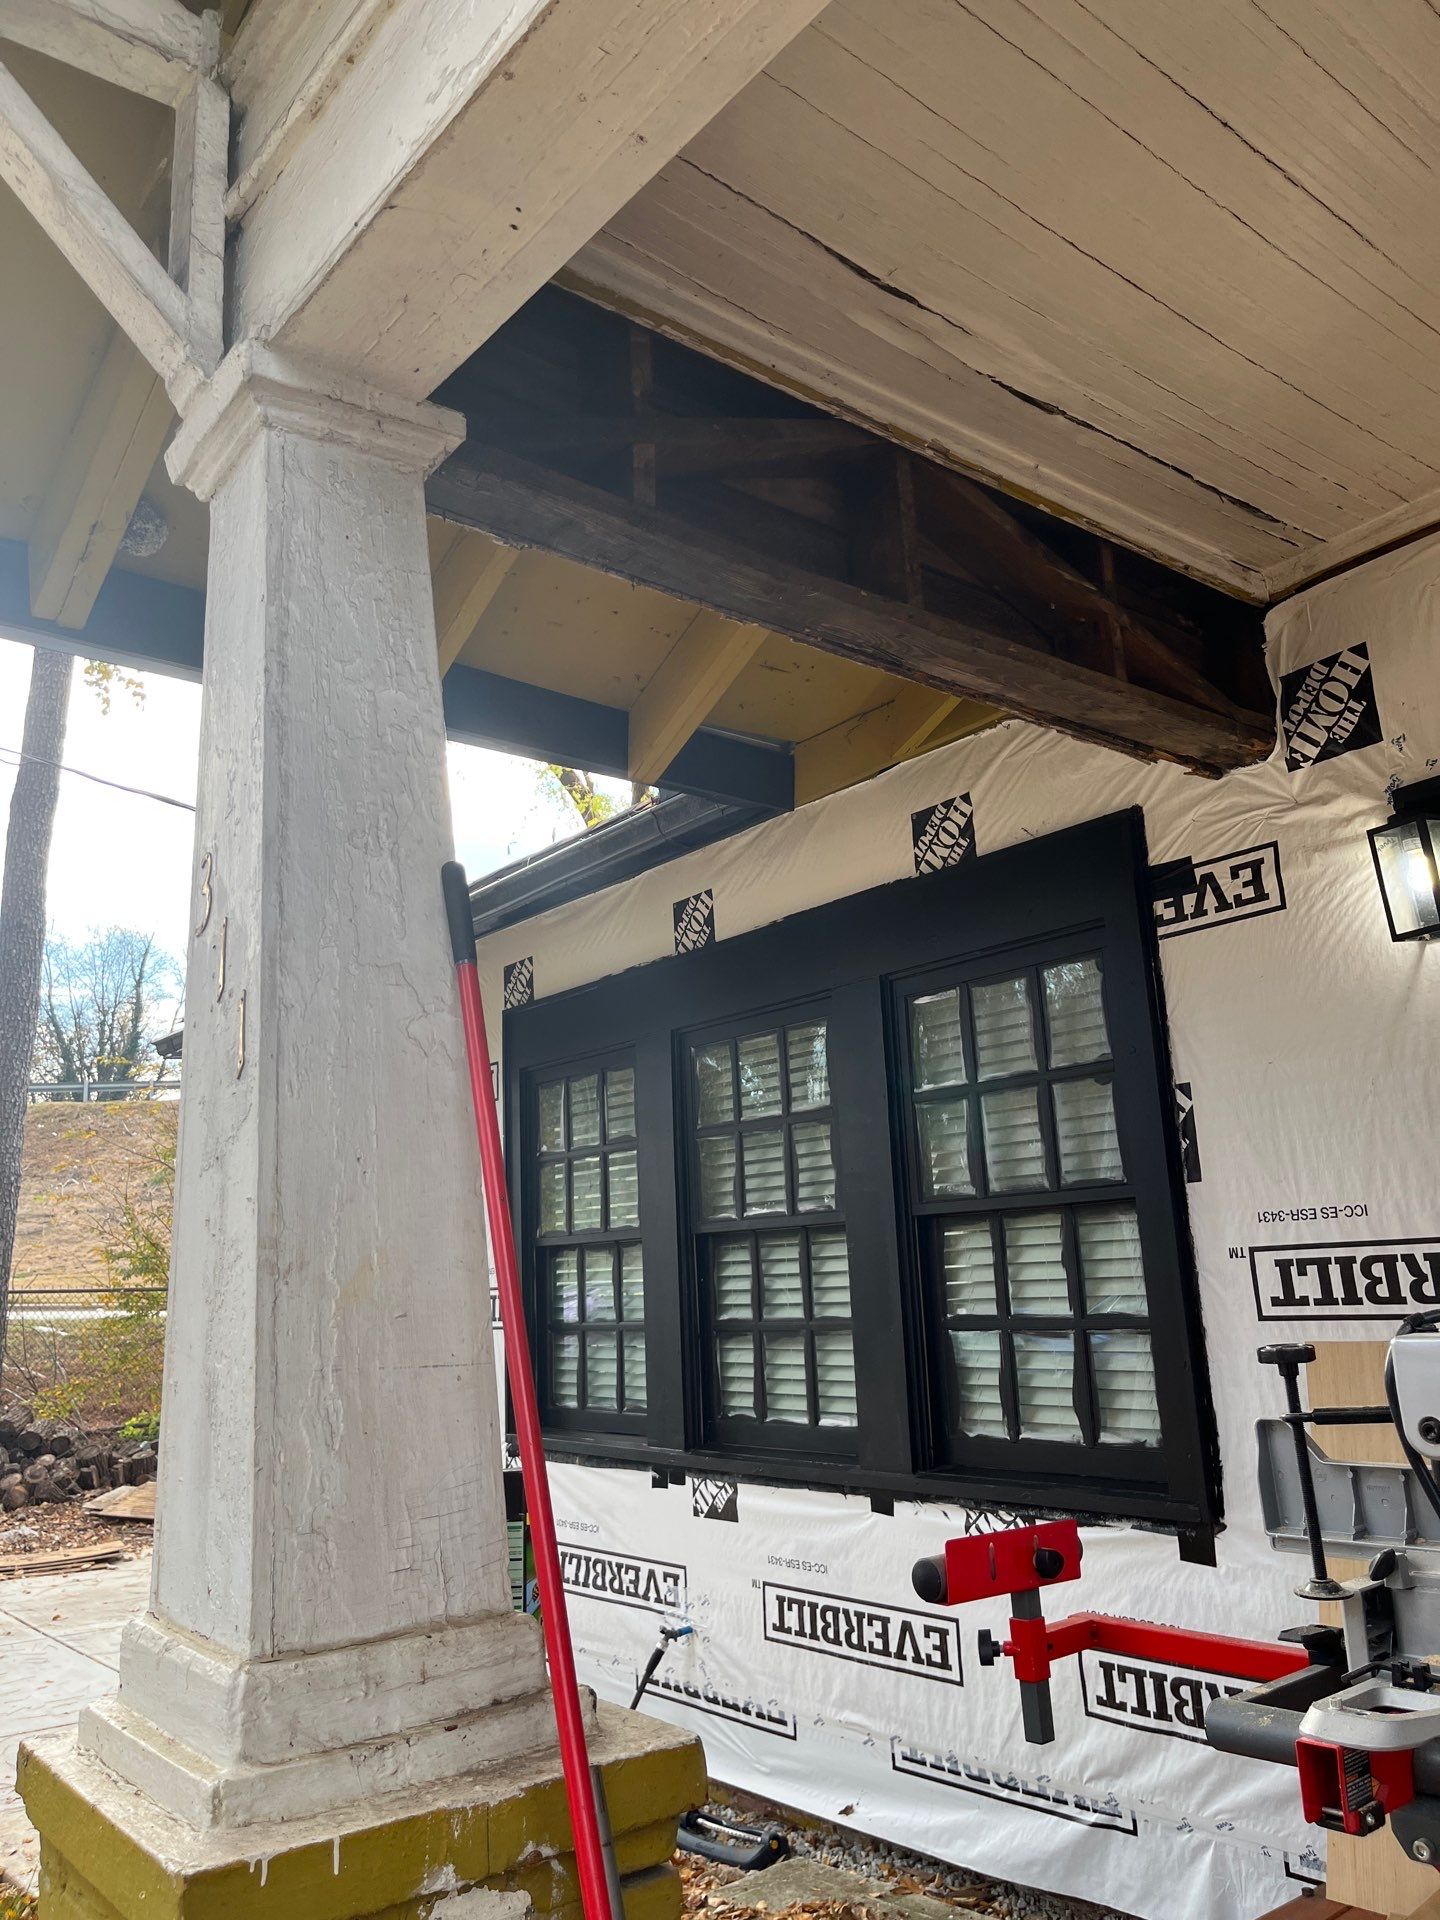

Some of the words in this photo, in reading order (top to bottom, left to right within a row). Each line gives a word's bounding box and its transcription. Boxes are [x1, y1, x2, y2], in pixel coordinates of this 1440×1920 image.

[1282, 662, 1330, 737] DEPOT
[1287, 649, 1371, 768] HOME
[1329, 699, 1367, 744] THE
[913, 804, 948, 861] DEPOT
[674, 896, 697, 943] DEPOT
[1257, 1207, 1317, 1223] ESR-3431
[1321, 1204, 1369, 1220] ICC-ES
[1228, 1247, 1246, 1259] TM
[767, 1554, 801, 1570] ESR-3431
[801, 1560, 829, 1575] ICC-ES
[772, 1594, 953, 1672] EVERBILT
[1096, 1660, 1244, 1730] BILT
